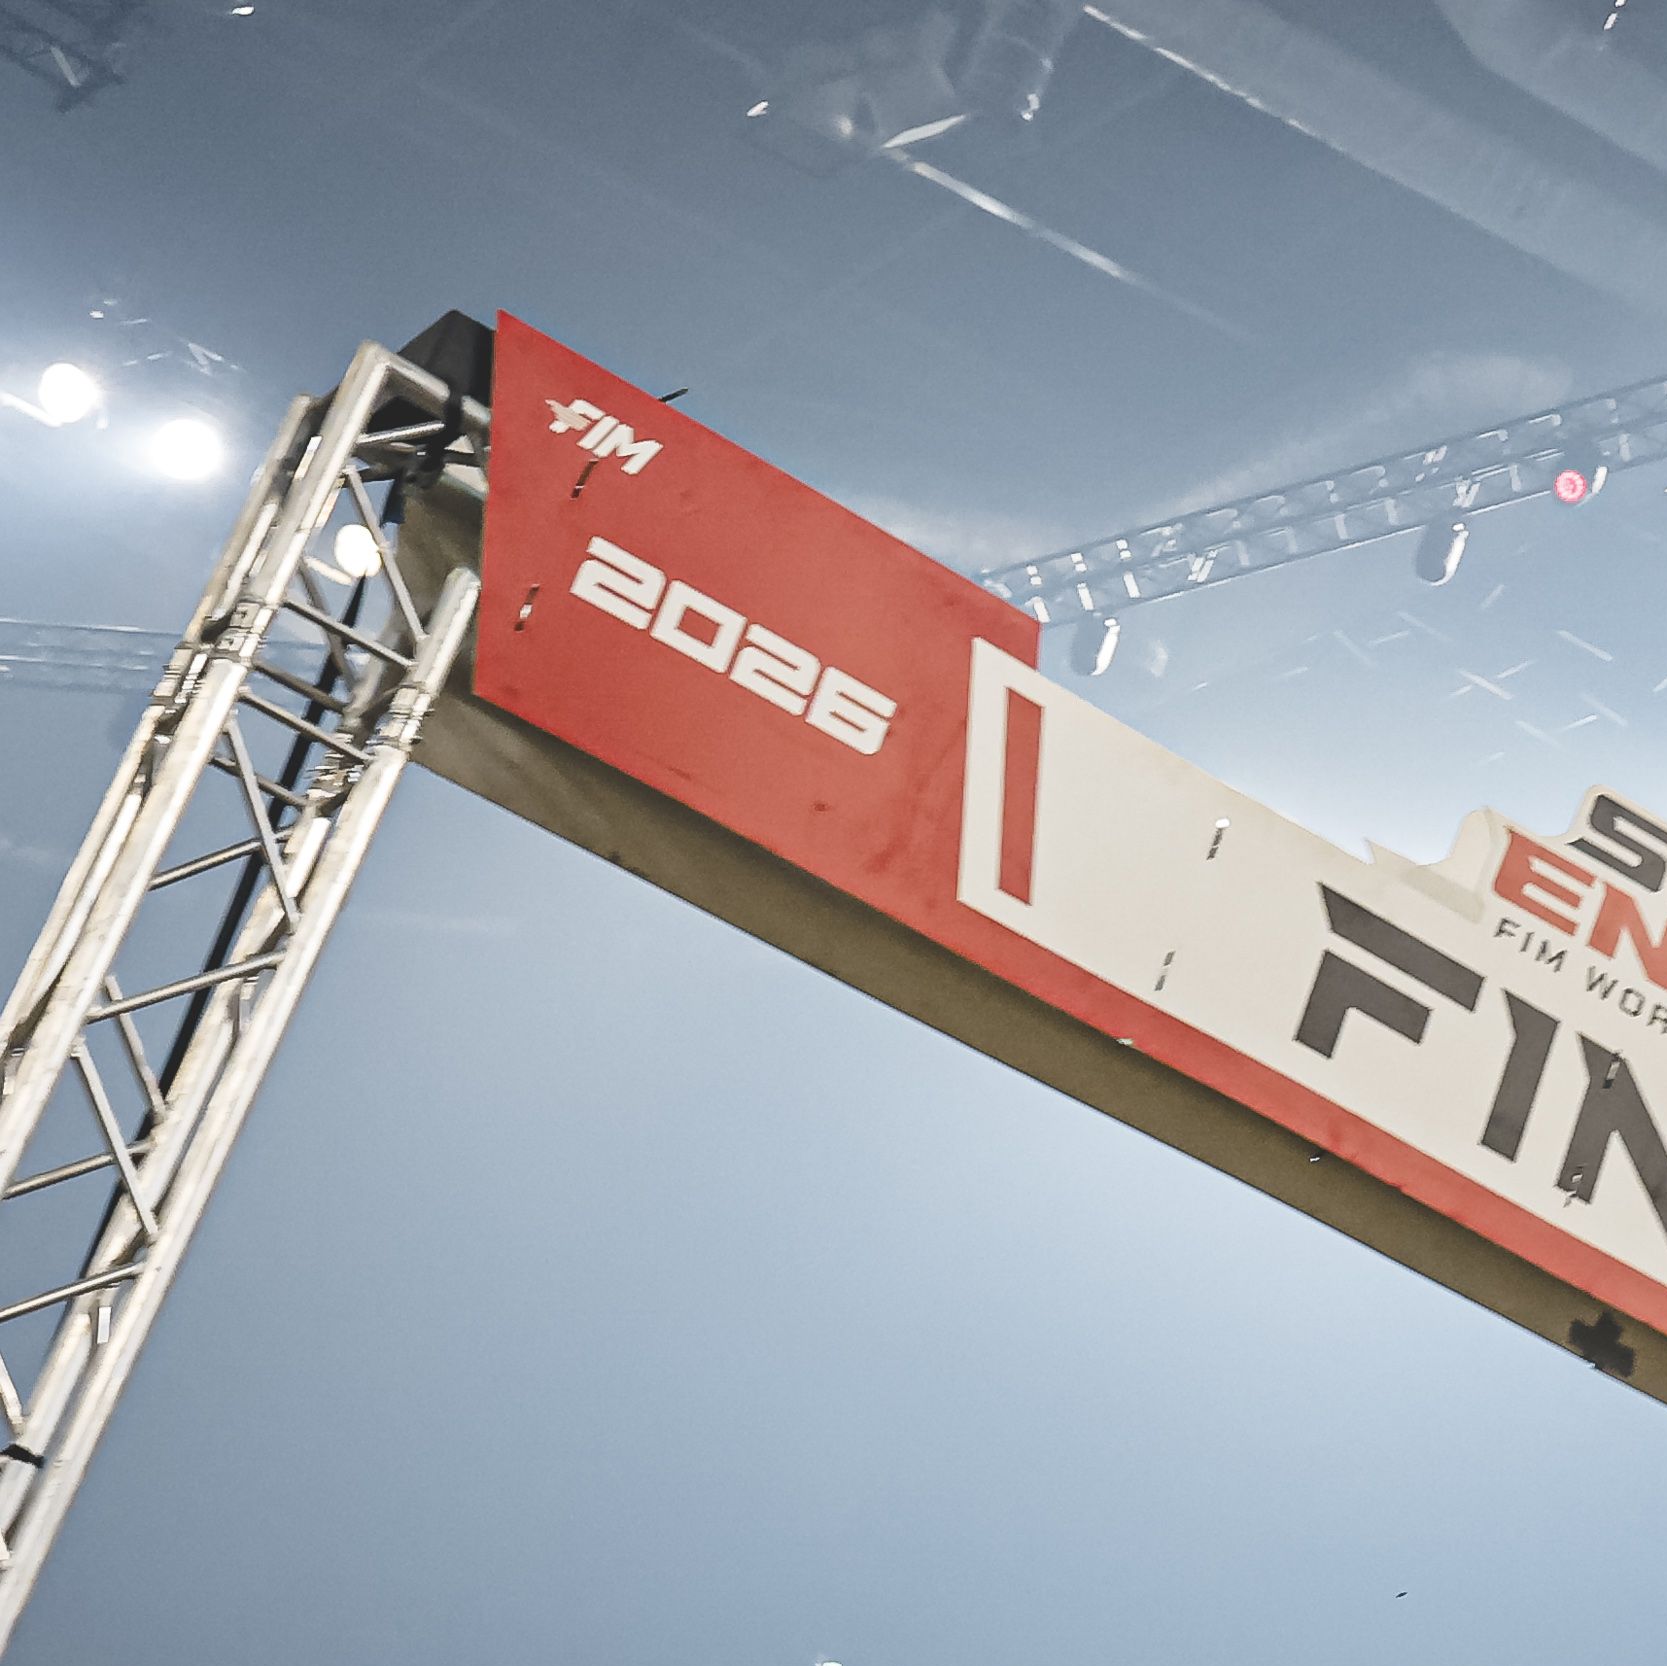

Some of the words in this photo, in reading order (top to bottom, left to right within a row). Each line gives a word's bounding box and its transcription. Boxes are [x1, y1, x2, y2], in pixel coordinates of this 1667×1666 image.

[545, 398, 663, 476] FIM
[570, 535, 897, 756] 2026
[1493, 917, 1564, 974] FIM
